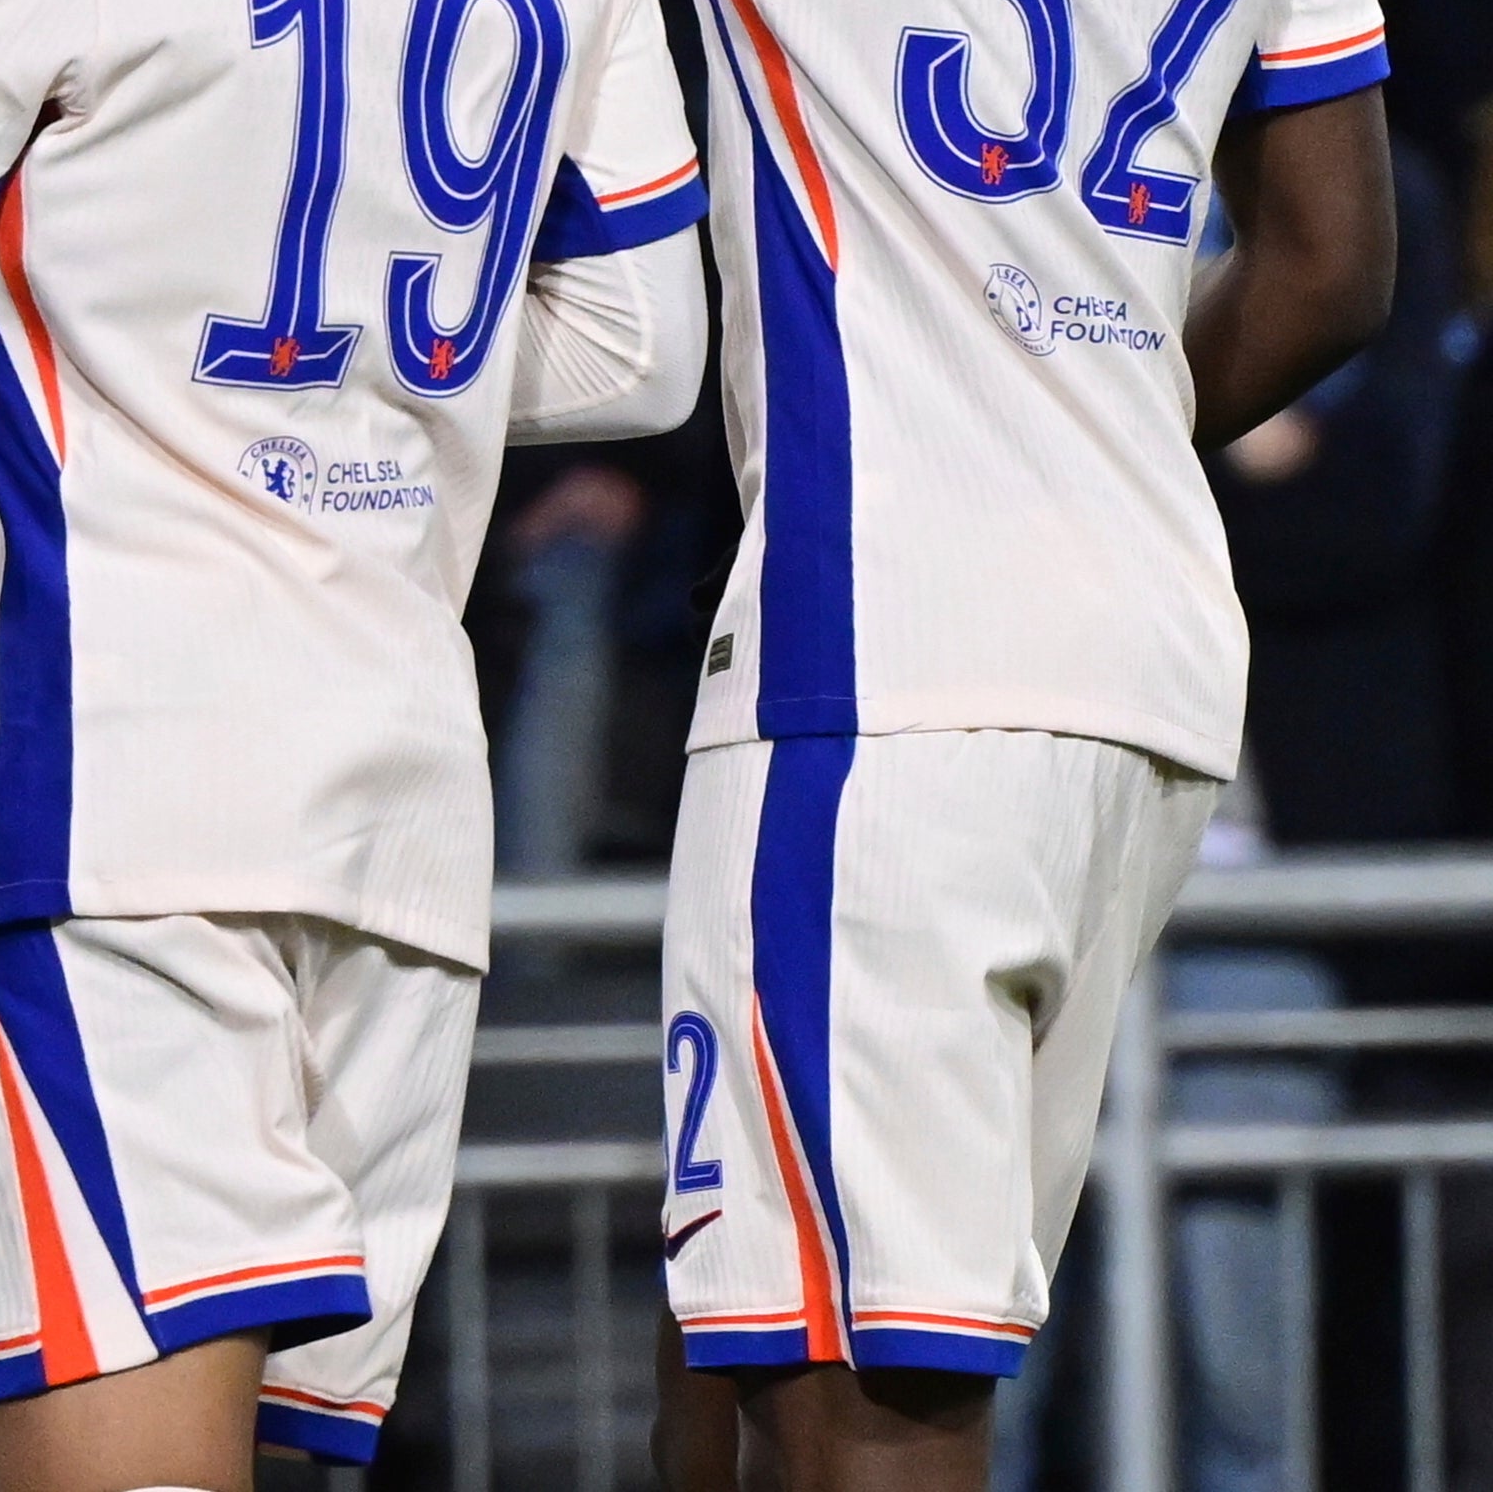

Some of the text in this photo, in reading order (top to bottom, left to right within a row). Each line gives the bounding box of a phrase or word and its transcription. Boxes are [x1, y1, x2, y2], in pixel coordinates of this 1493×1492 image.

[327, 460, 404, 485] CHELSEA
[321, 484, 435, 513] FOUNDATION
[665, 1010, 724, 1196] 2
